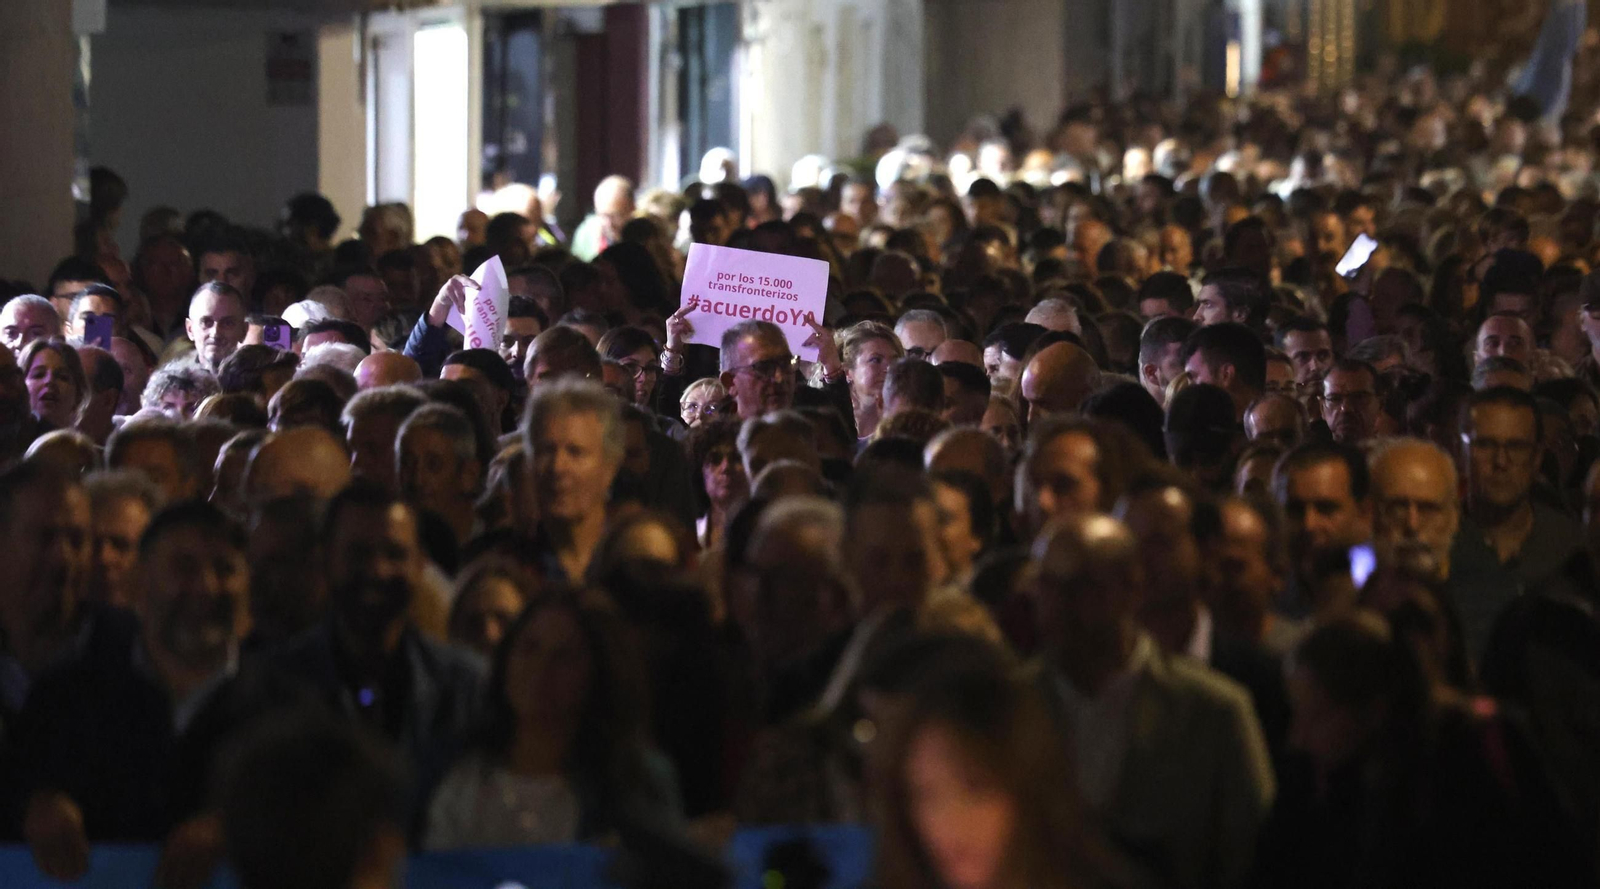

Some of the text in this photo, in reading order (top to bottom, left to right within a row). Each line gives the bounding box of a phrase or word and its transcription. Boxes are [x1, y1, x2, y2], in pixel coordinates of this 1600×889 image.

[717, 271, 793, 289] por los 15.000
[708, 280, 799, 301] transfronterizos
[483, 298, 498, 316] por
